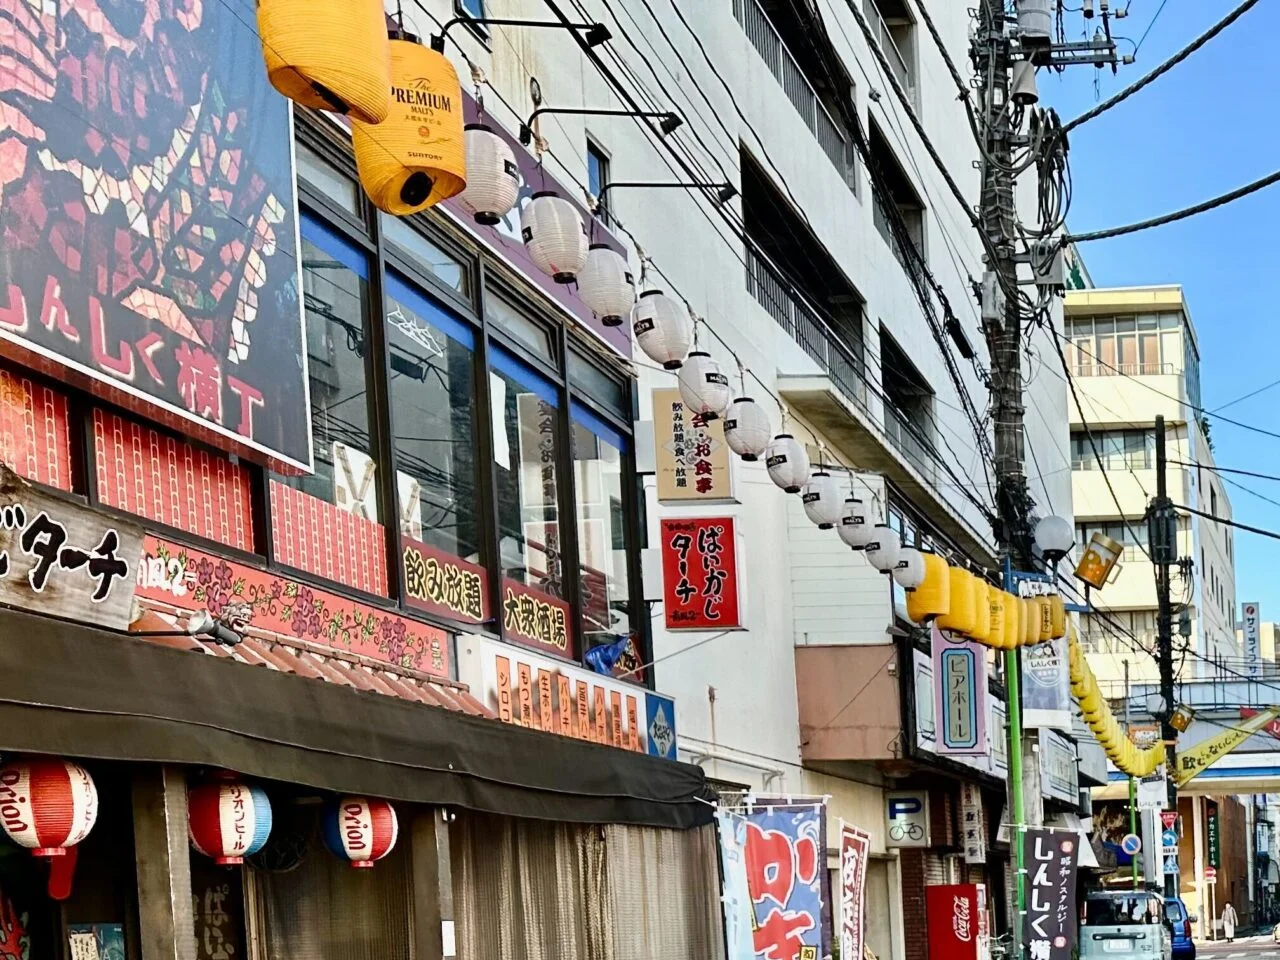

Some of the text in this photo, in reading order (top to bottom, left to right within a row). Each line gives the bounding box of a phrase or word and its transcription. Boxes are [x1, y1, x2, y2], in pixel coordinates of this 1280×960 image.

[407, 151, 443, 160] SUNTORY
[403, 546, 483, 621] 飲み放題
[670, 532, 698, 606] ターチ
[698, 525, 728, 620] ぱいかじ
[503, 587, 567, 650] 大衆酒場
[951, 658, 967, 738] ビアホール
[889, 797, 922, 820] P
[1057, 856, 1071, 933] 昭和ノスタルジー
